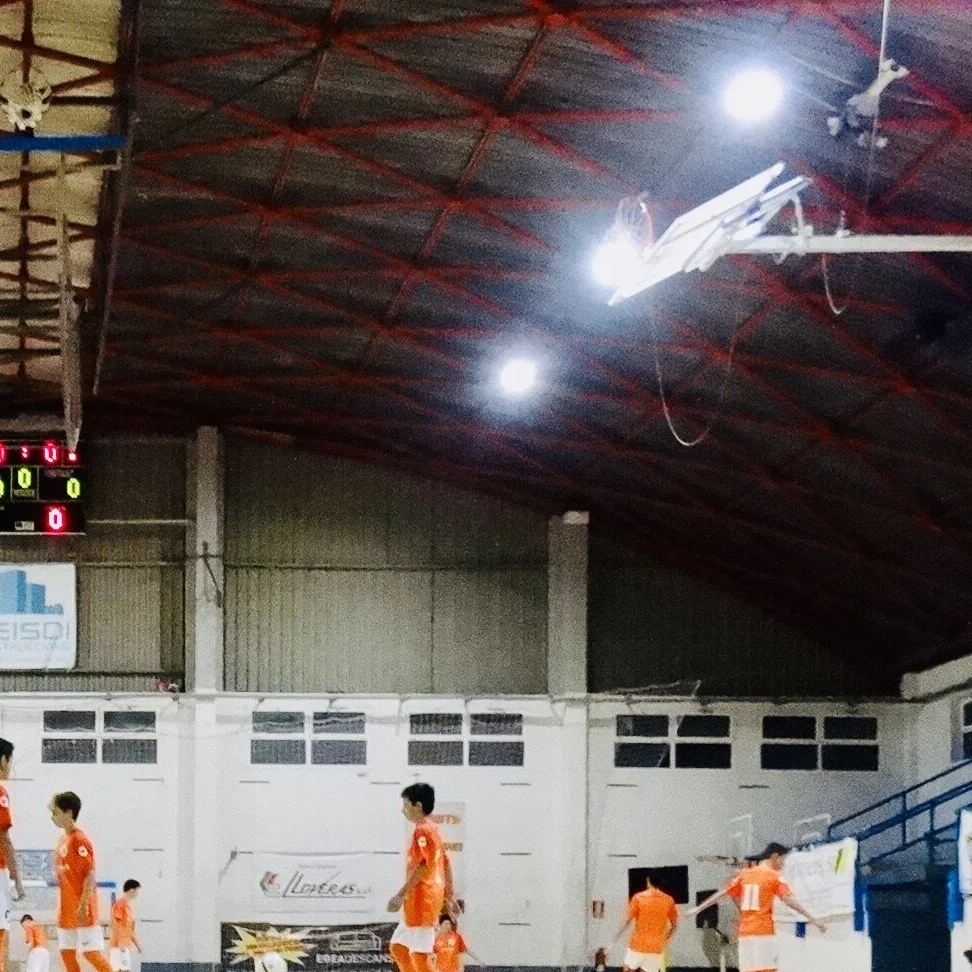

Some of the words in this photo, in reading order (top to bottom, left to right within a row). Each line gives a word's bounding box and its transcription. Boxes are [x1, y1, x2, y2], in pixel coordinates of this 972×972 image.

[17, 468, 31, 489] 0
[67, 478, 80, 498] 0
[48, 508, 63, 530] 0
[741, 884, 760, 911] 11
